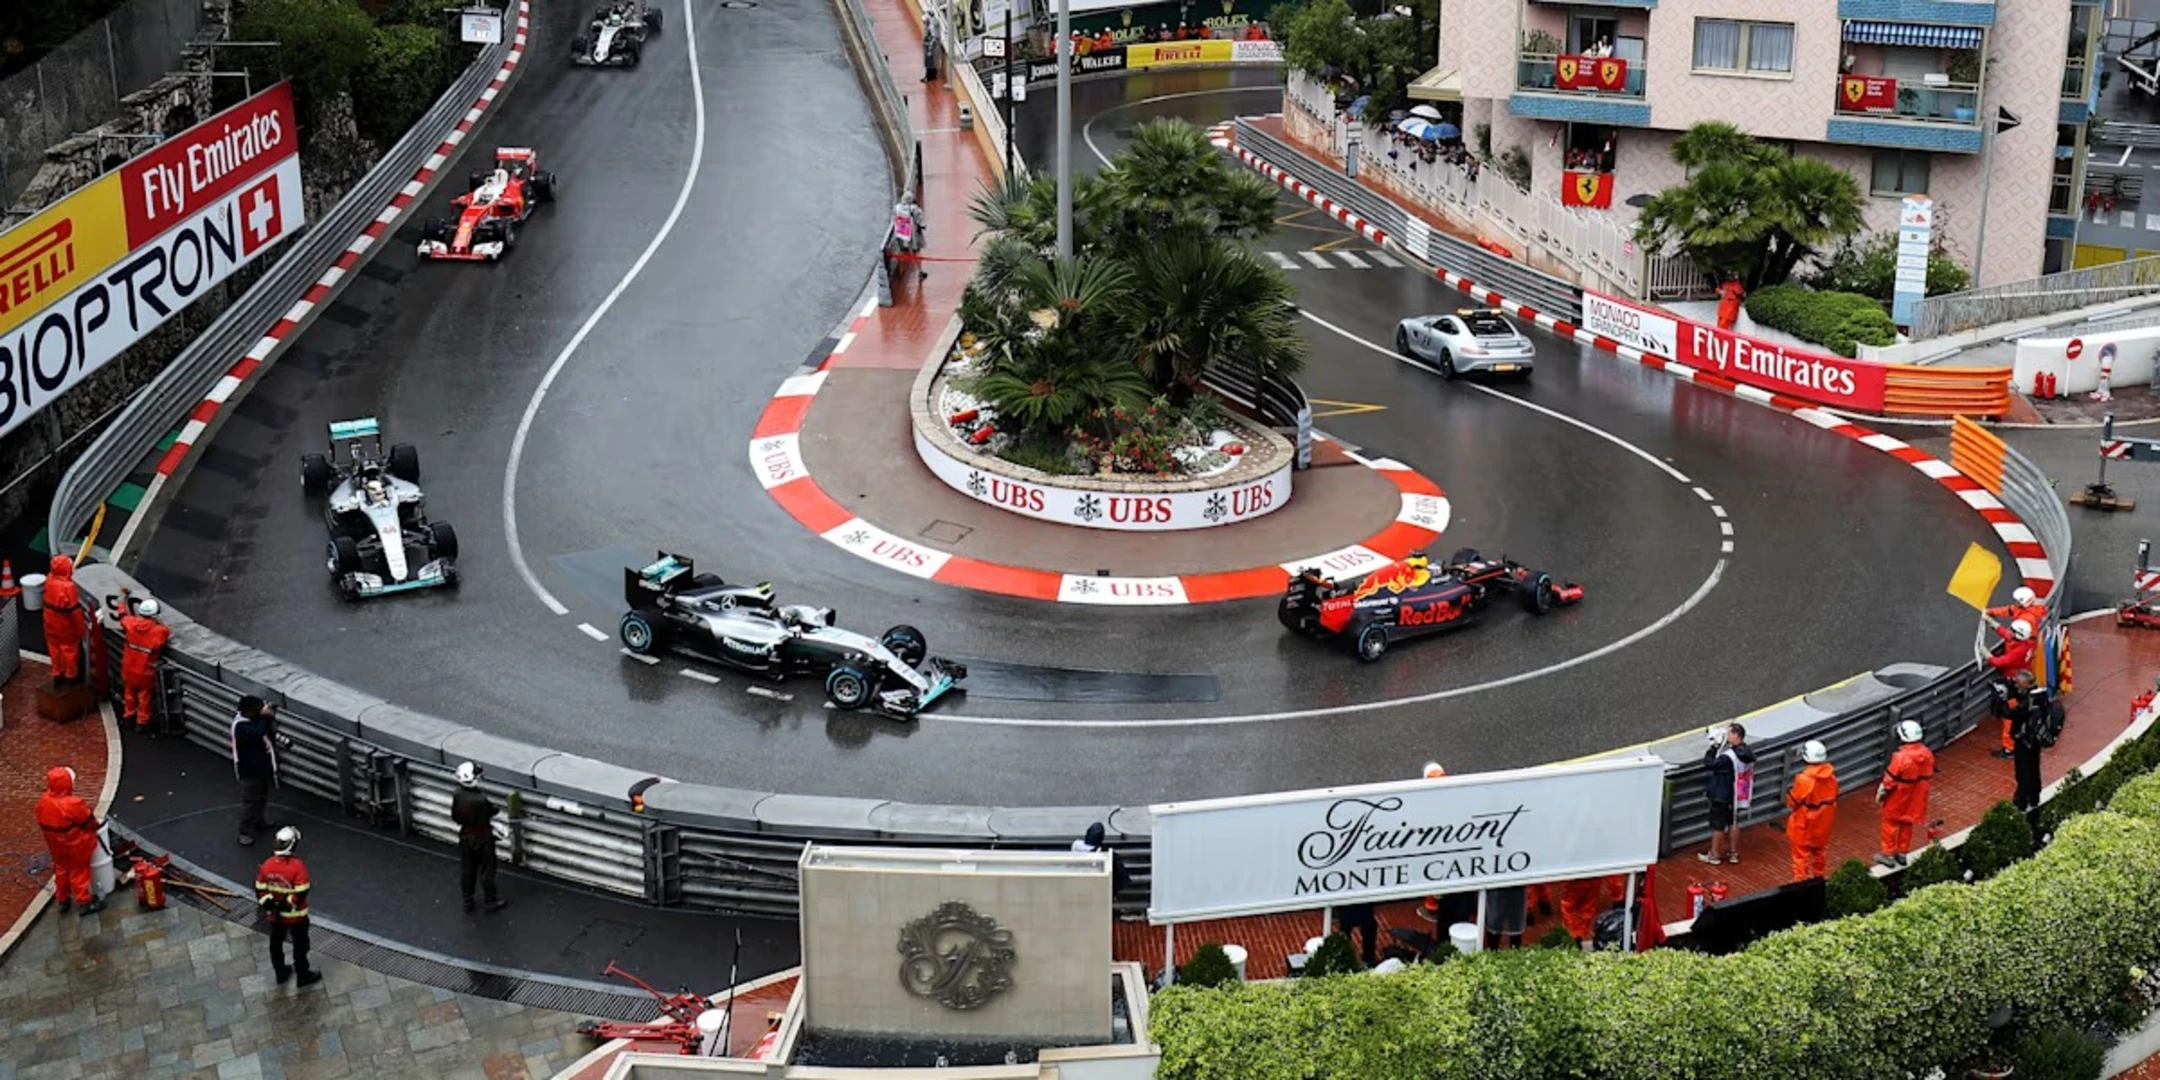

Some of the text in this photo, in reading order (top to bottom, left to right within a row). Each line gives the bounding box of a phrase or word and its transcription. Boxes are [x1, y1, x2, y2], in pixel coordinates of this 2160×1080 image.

[1206, 14, 1249, 28] ROLEX
[1081, 55, 1122, 69] WALKER
[142, 108, 282, 220] Fly Emirates
[0, 202, 237, 428] BIOPTRON
[1590, 299, 1640, 330] MONACO
[1693, 326, 1855, 395] Fly Emirates
[765, 451, 795, 480] UBS
[991, 478, 1045, 512] UBS
[1109, 497, 1172, 523] UBS
[1232, 480, 1273, 516] UBS
[872, 540, 931, 568] UBS
[1323, 549, 1375, 572] UBS
[1110, 582, 1175, 598] UBS
[1323, 600, 1353, 611] TOTAL
[1297, 797, 1531, 869] Fairmont
[1294, 850, 1532, 897] MONTE CARLO
